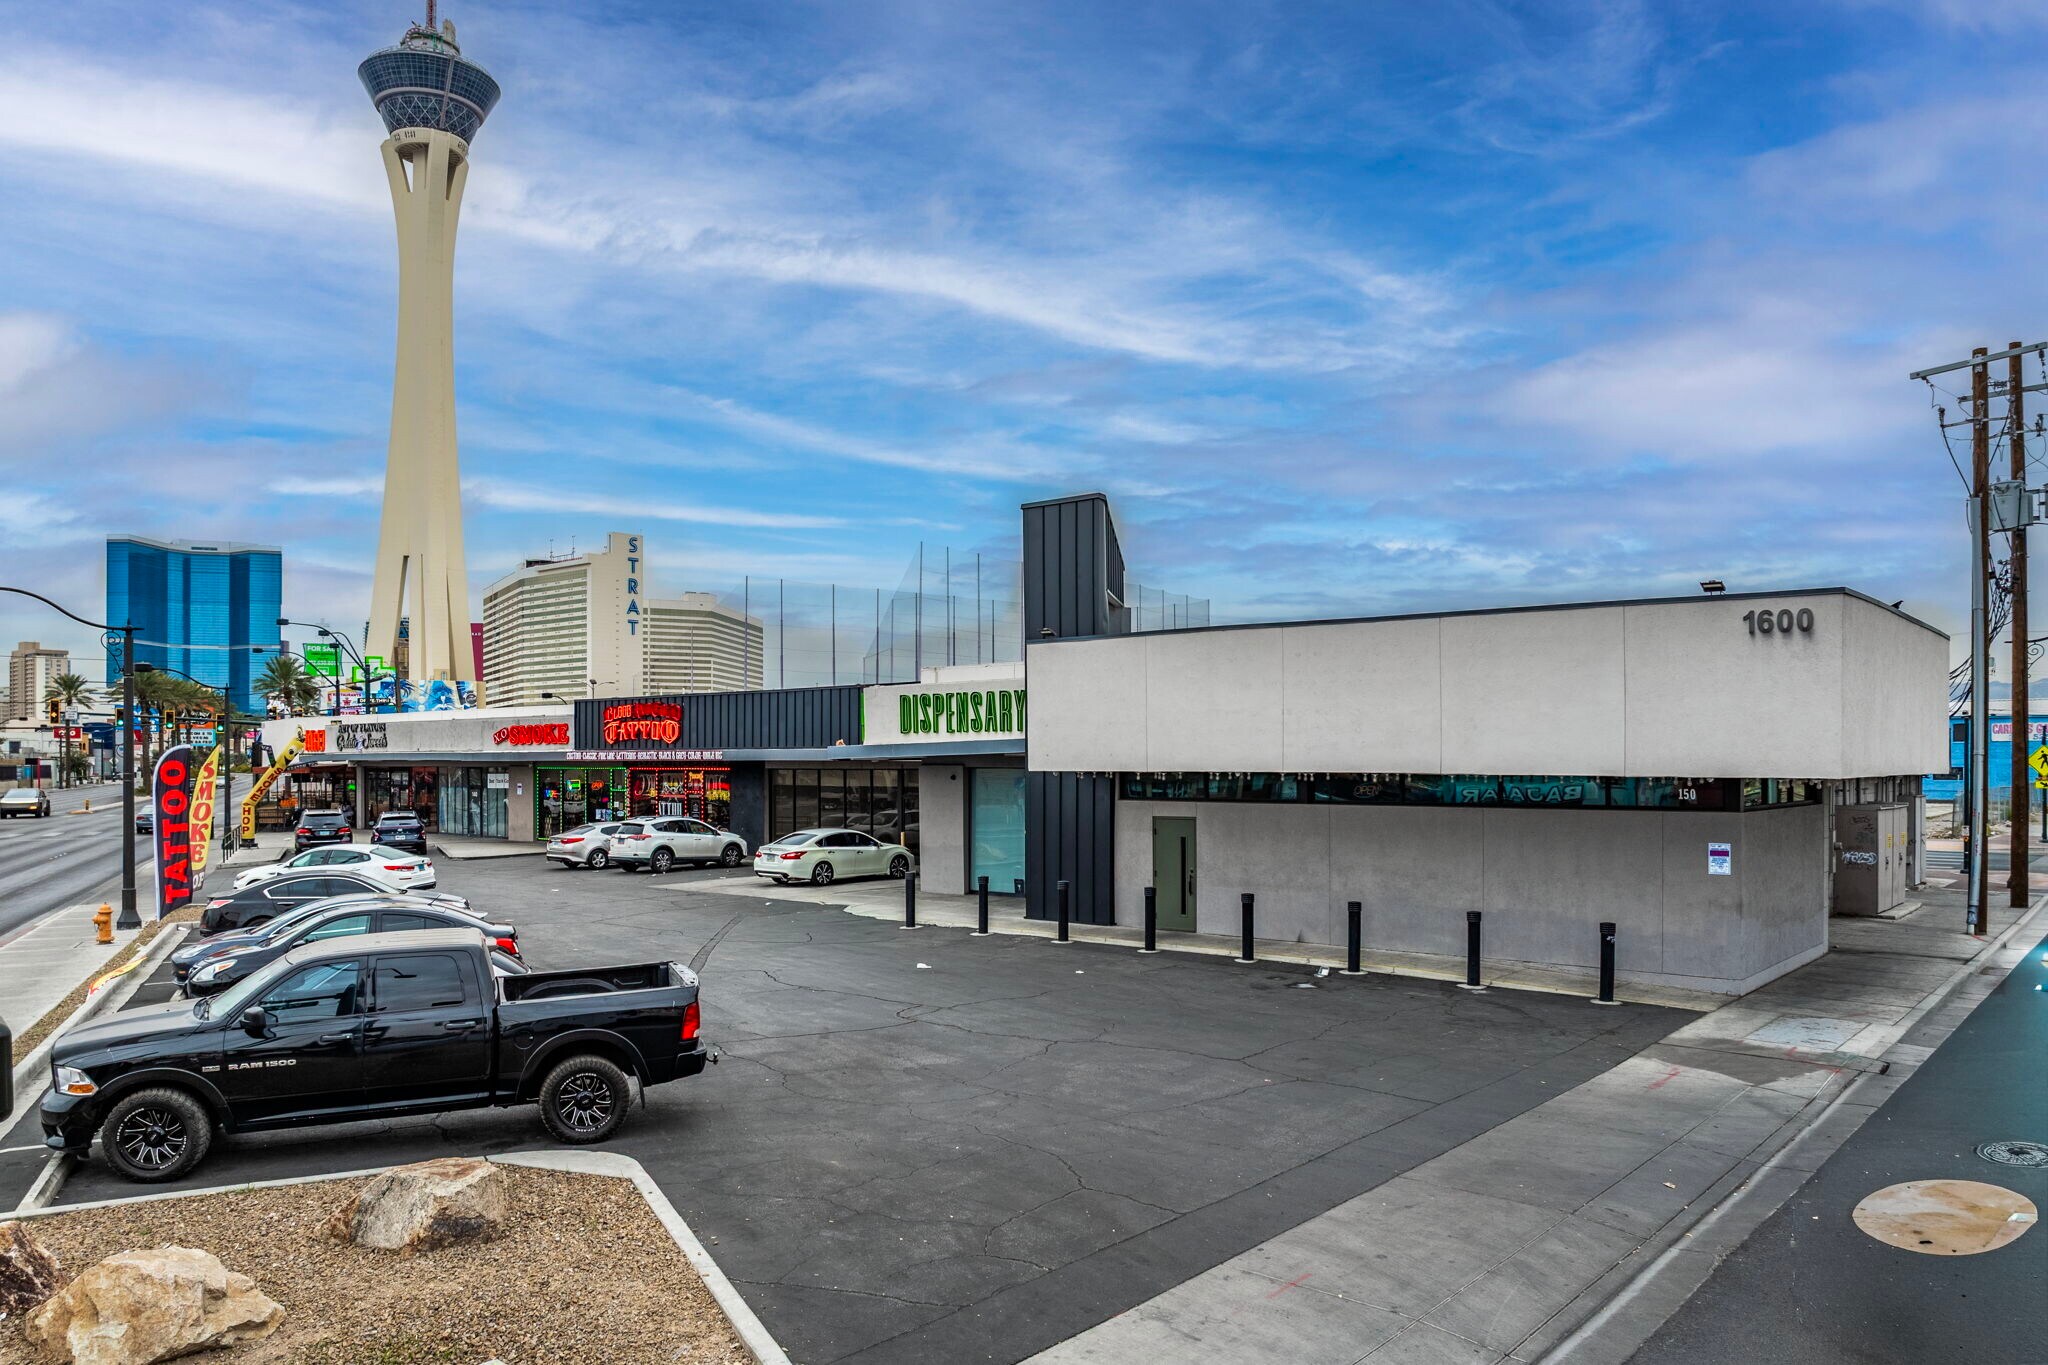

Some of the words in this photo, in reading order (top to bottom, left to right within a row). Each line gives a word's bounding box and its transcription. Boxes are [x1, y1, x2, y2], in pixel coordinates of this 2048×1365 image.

[627, 537, 640, 635] STRAT
[1743, 607, 1814, 635] 1600
[899, 689, 1026, 734] DISPENSARY
[509, 723, 569, 745] SMOKE
[603, 719, 680, 745] TATTOO
[250, 767, 283, 802] SMOKE
[1678, 788, 1696, 800] 150
[191, 760, 215, 863] SMOKE
[160, 760, 190, 904] TATTOO
[228, 1062, 263, 1070] RAM
[265, 1059, 297, 1067] 1500
